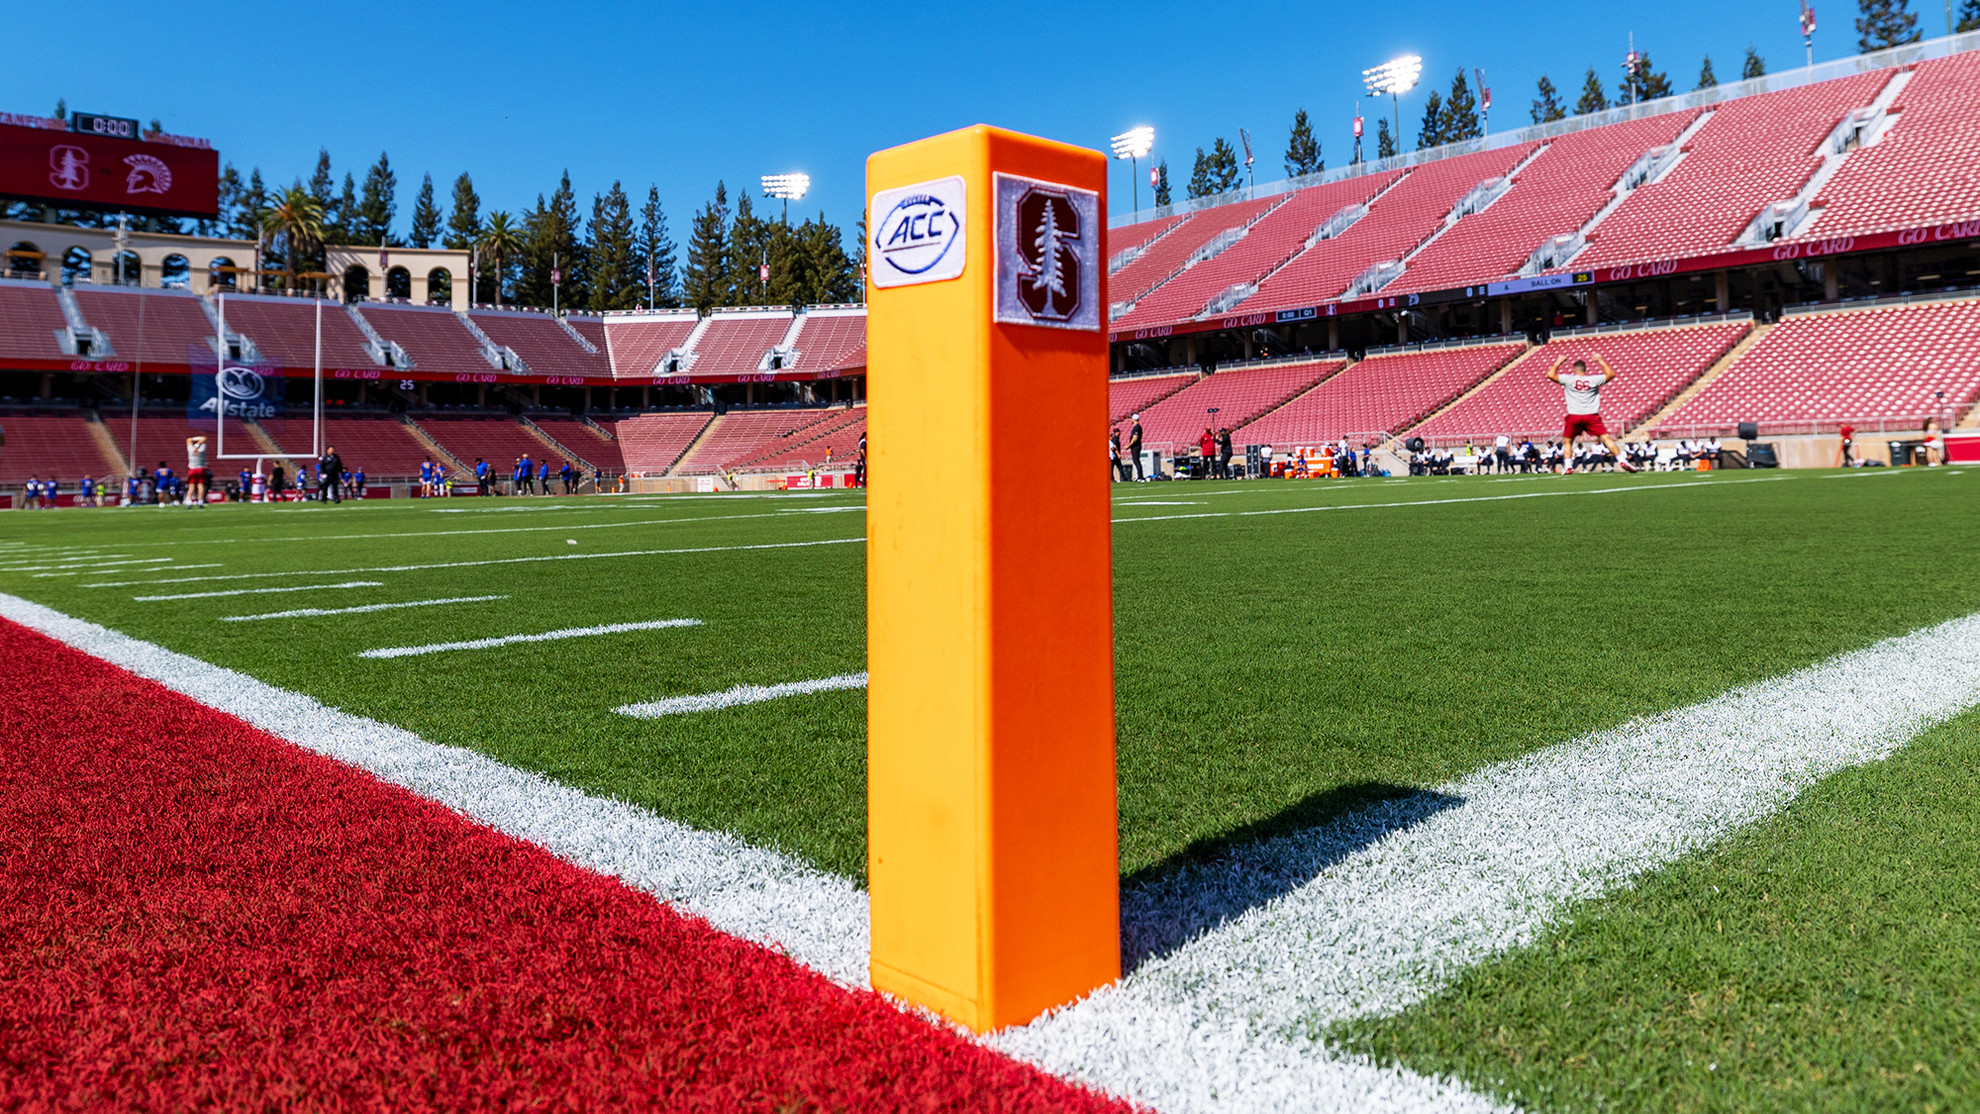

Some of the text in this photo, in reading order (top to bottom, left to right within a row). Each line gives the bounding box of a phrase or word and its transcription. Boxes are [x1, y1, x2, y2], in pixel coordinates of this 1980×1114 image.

[93, 117, 130, 135] 0:00
[888, 209, 945, 246] ACC
[1898, 227, 1927, 245] GO
[1773, 236, 1855, 261] GO CARD
[1610, 259, 1678, 281] GO CARD
[1531, 279, 1549, 288] BALL
[1551, 277, 1562, 285] ON
[1466, 287, 1473, 297] 0
[1378, 298, 1384, 309] 0
[1303, 309, 1312, 317] Q1
[1223, 313, 1266, 329] GO CARD
[1135, 326, 1173, 340] GO CARD
[71, 360, 91, 372] GO
[335, 369, 350, 379] GO
[456, 373, 471, 383] GO
[737, 373, 775, 383] GO CARD
[400, 380, 414, 390] 25
[546, 376, 559, 385] GO
[653, 375, 690, 386] GO CARD
